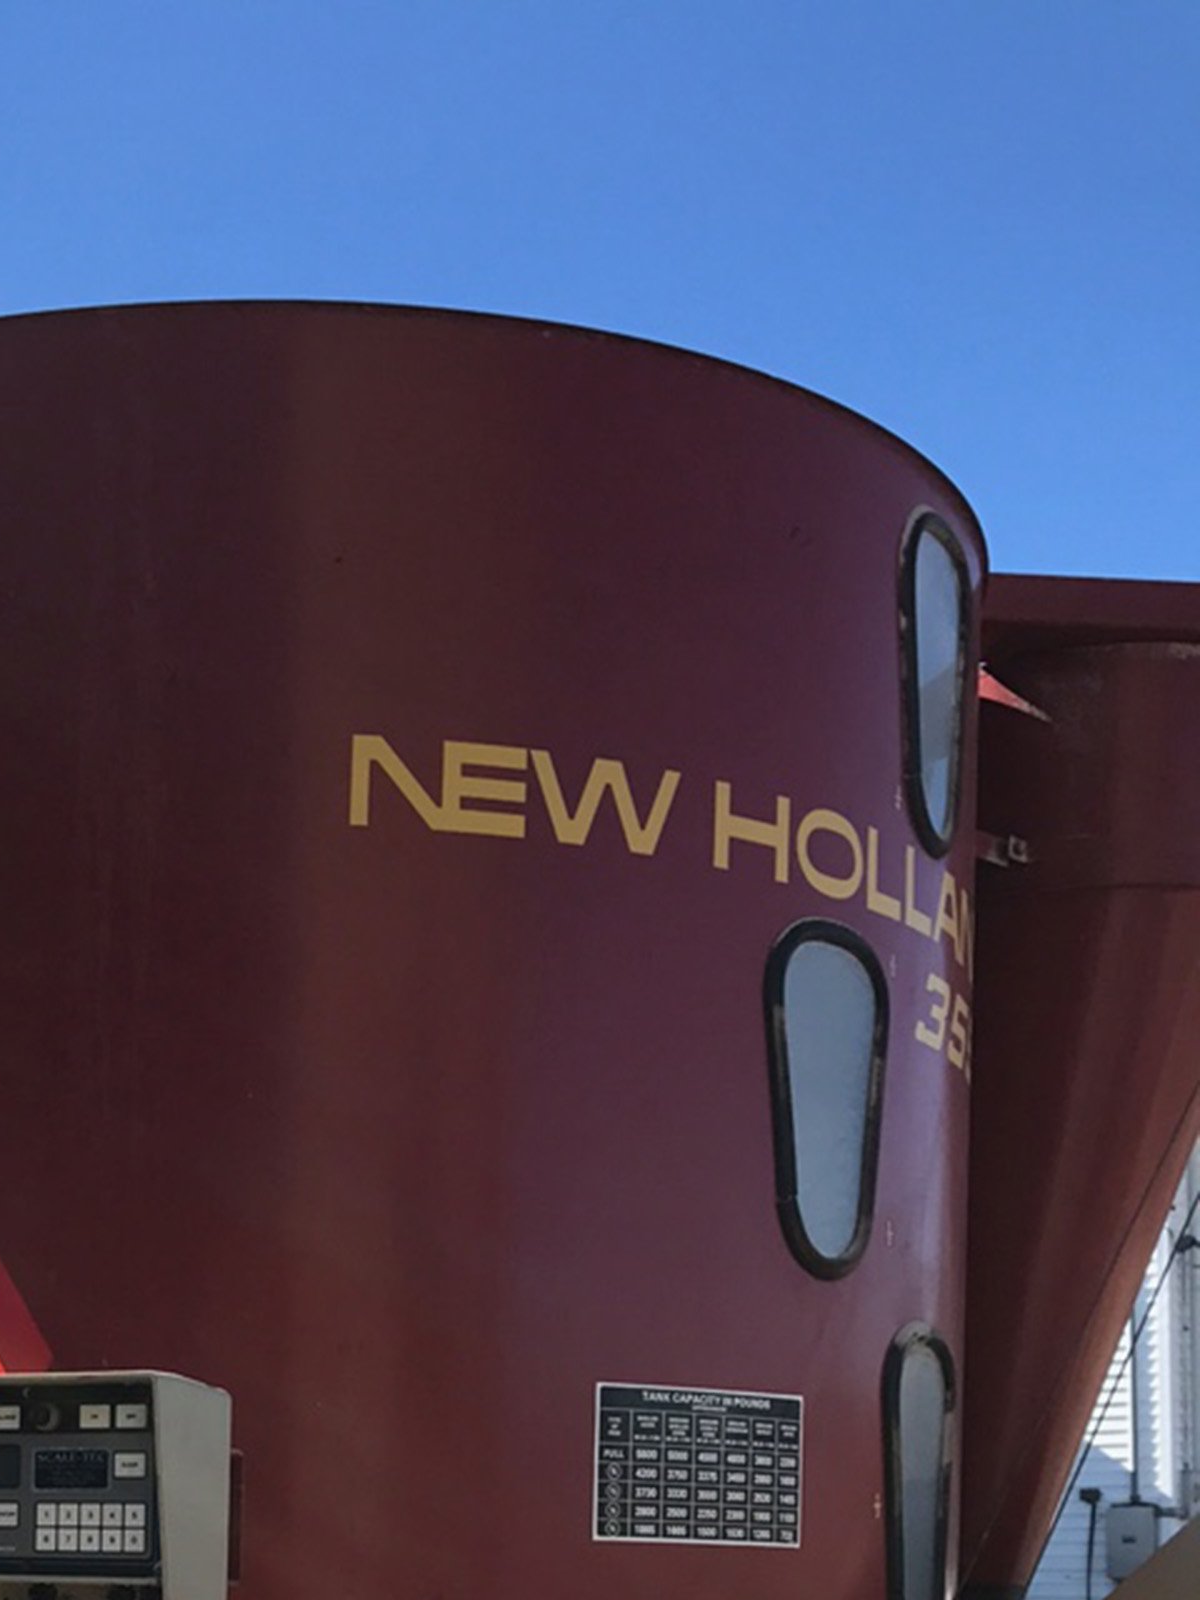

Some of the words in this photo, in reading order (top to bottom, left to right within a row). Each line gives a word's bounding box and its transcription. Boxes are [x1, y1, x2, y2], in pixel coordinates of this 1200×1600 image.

[349, 734, 681, 856] NEW
[915, 973, 971, 1085] 35
[642, 1391, 670, 1401] TANK
[673, 1393, 721, 1406] CAPACITY
[723, 1398, 733, 1406] IN
[735, 1399, 771, 1409] POUNDS
[603, 1450, 624, 1459] FULL
